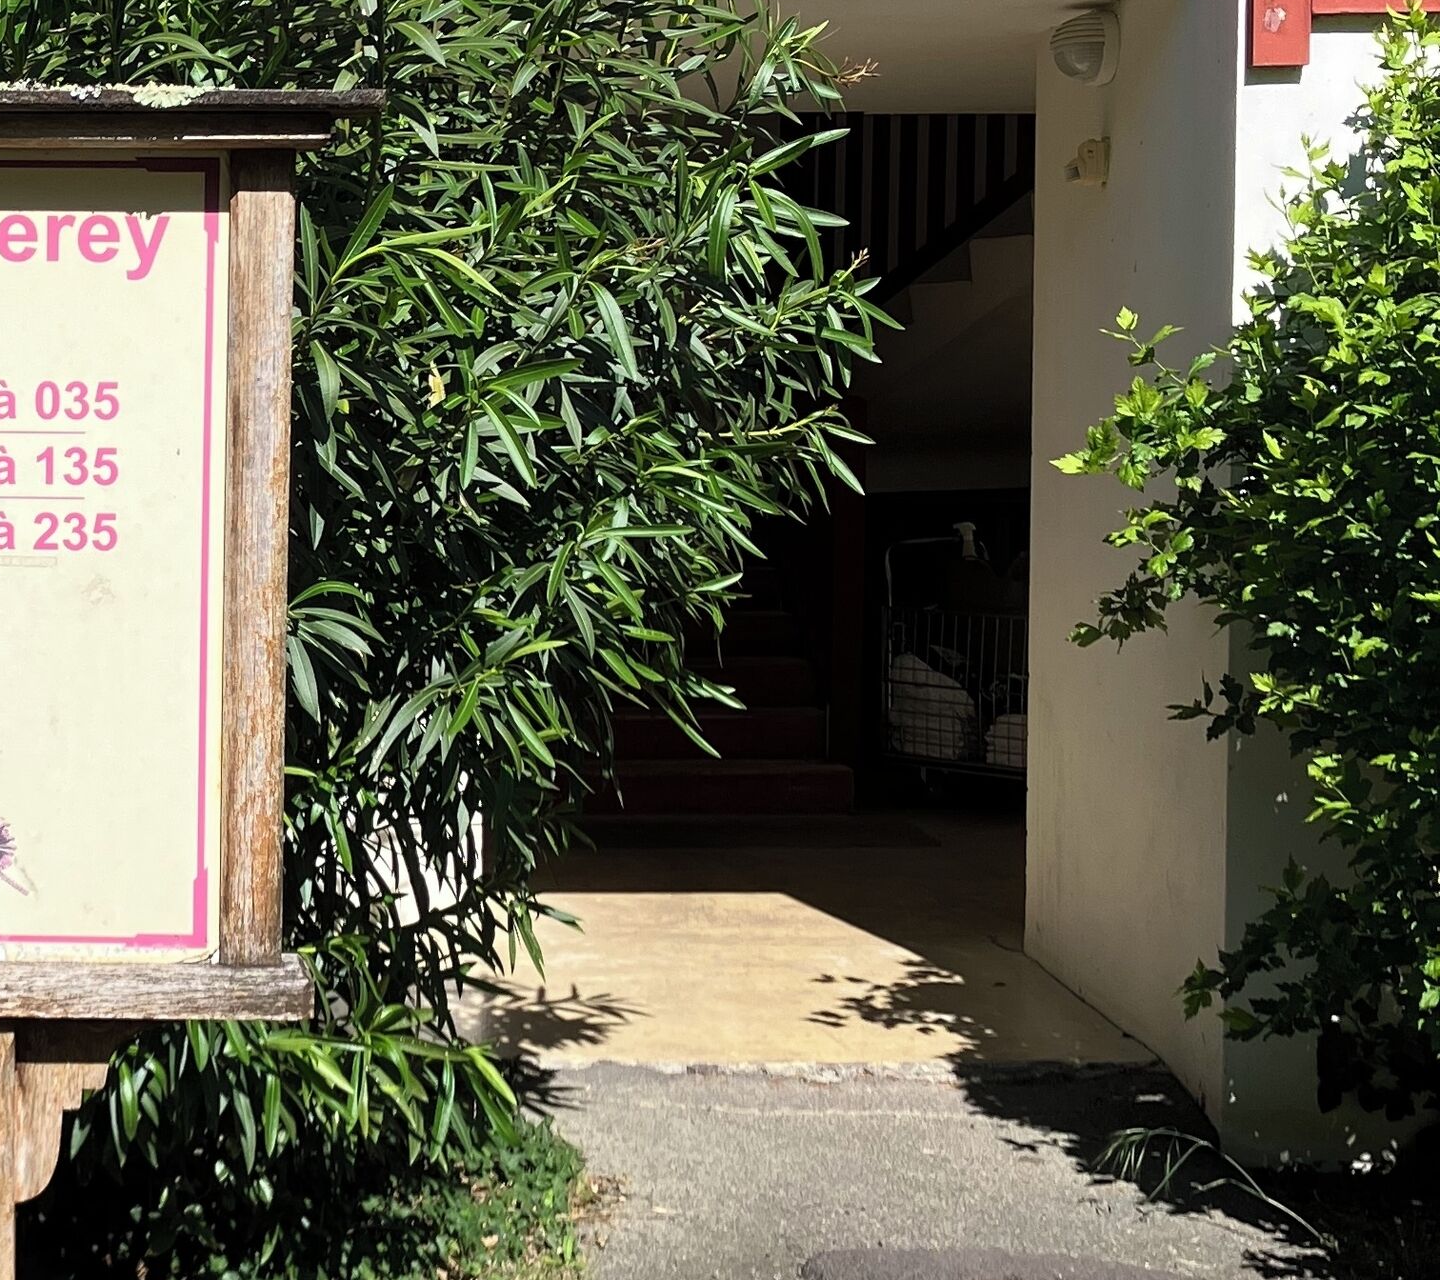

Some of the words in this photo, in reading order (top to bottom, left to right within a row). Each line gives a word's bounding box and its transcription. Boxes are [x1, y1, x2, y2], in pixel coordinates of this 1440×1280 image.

[35, 380, 120, 421] 035
[35, 446, 119, 486] 135
[32, 511, 118, 552] 235
